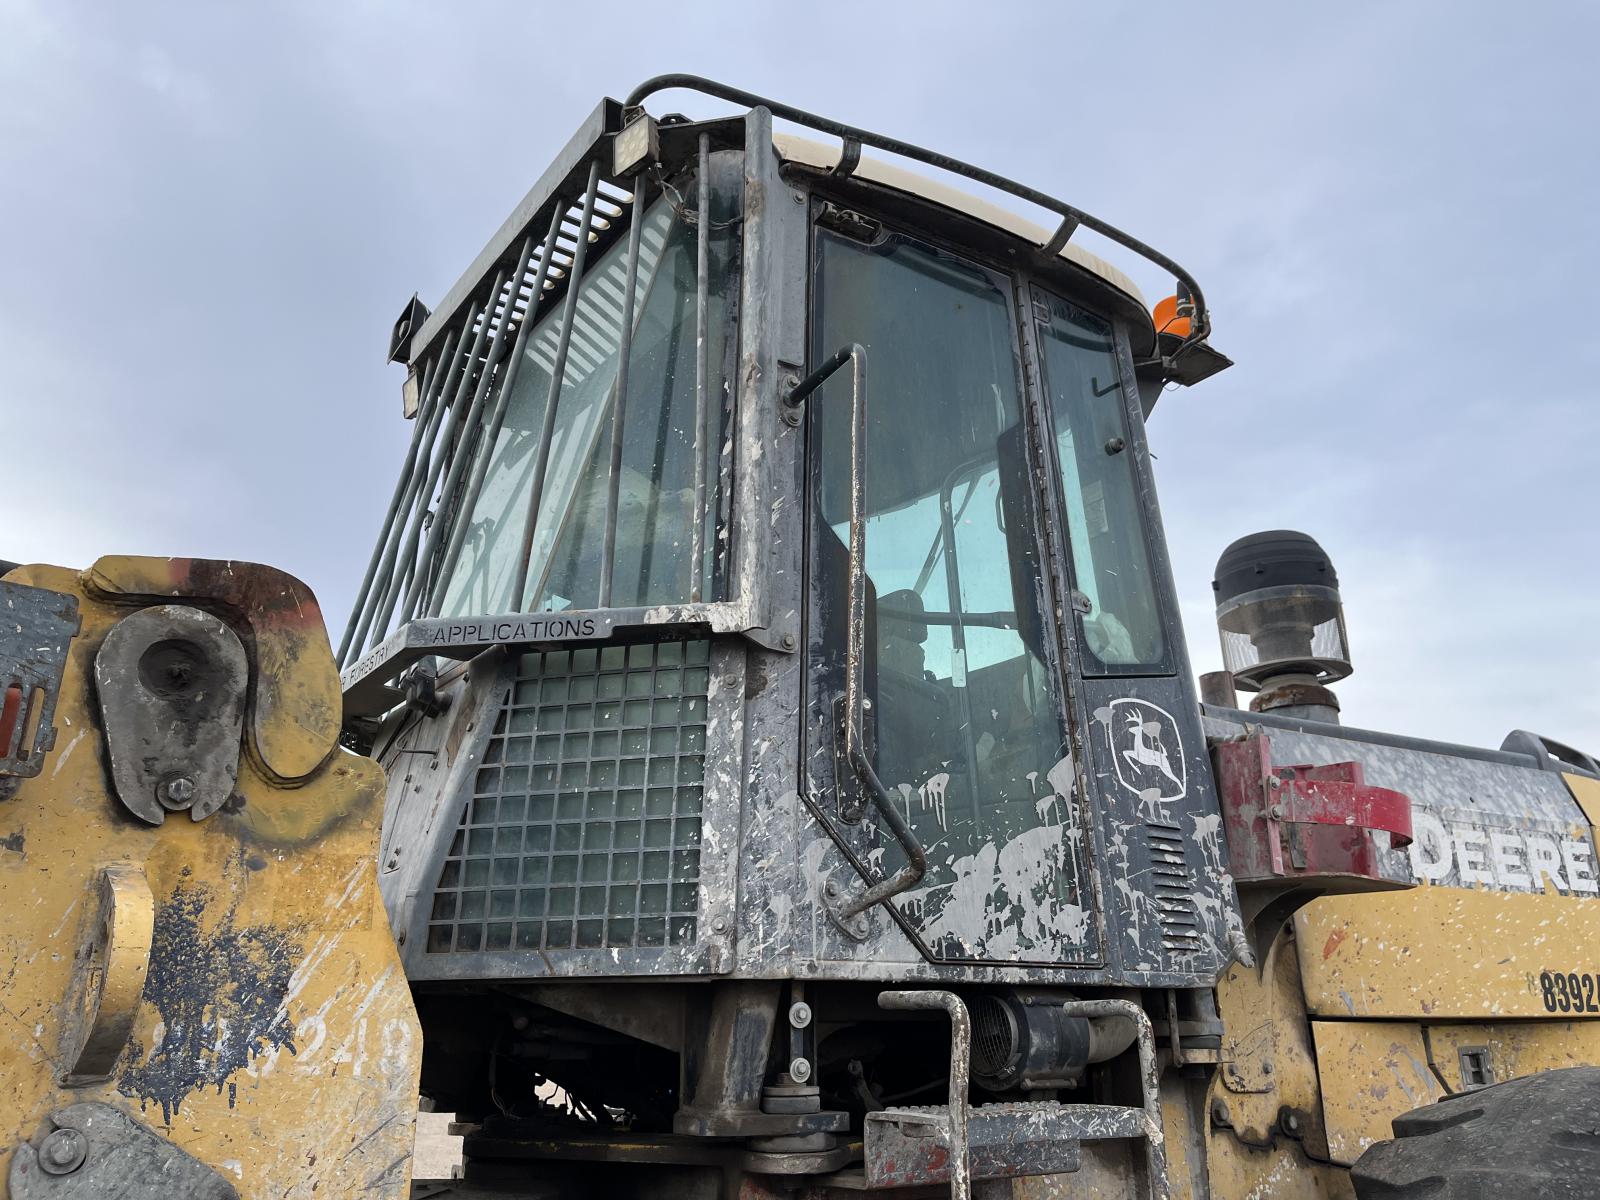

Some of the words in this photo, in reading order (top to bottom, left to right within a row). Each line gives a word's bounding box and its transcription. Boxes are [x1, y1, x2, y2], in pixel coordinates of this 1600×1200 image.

[433, 618, 595, 643] APPLICATIONS
[349, 642, 391, 683] FORESTRY
[1410, 811, 1598, 892] DEERE
[1540, 971, 1600, 1013] 8392
